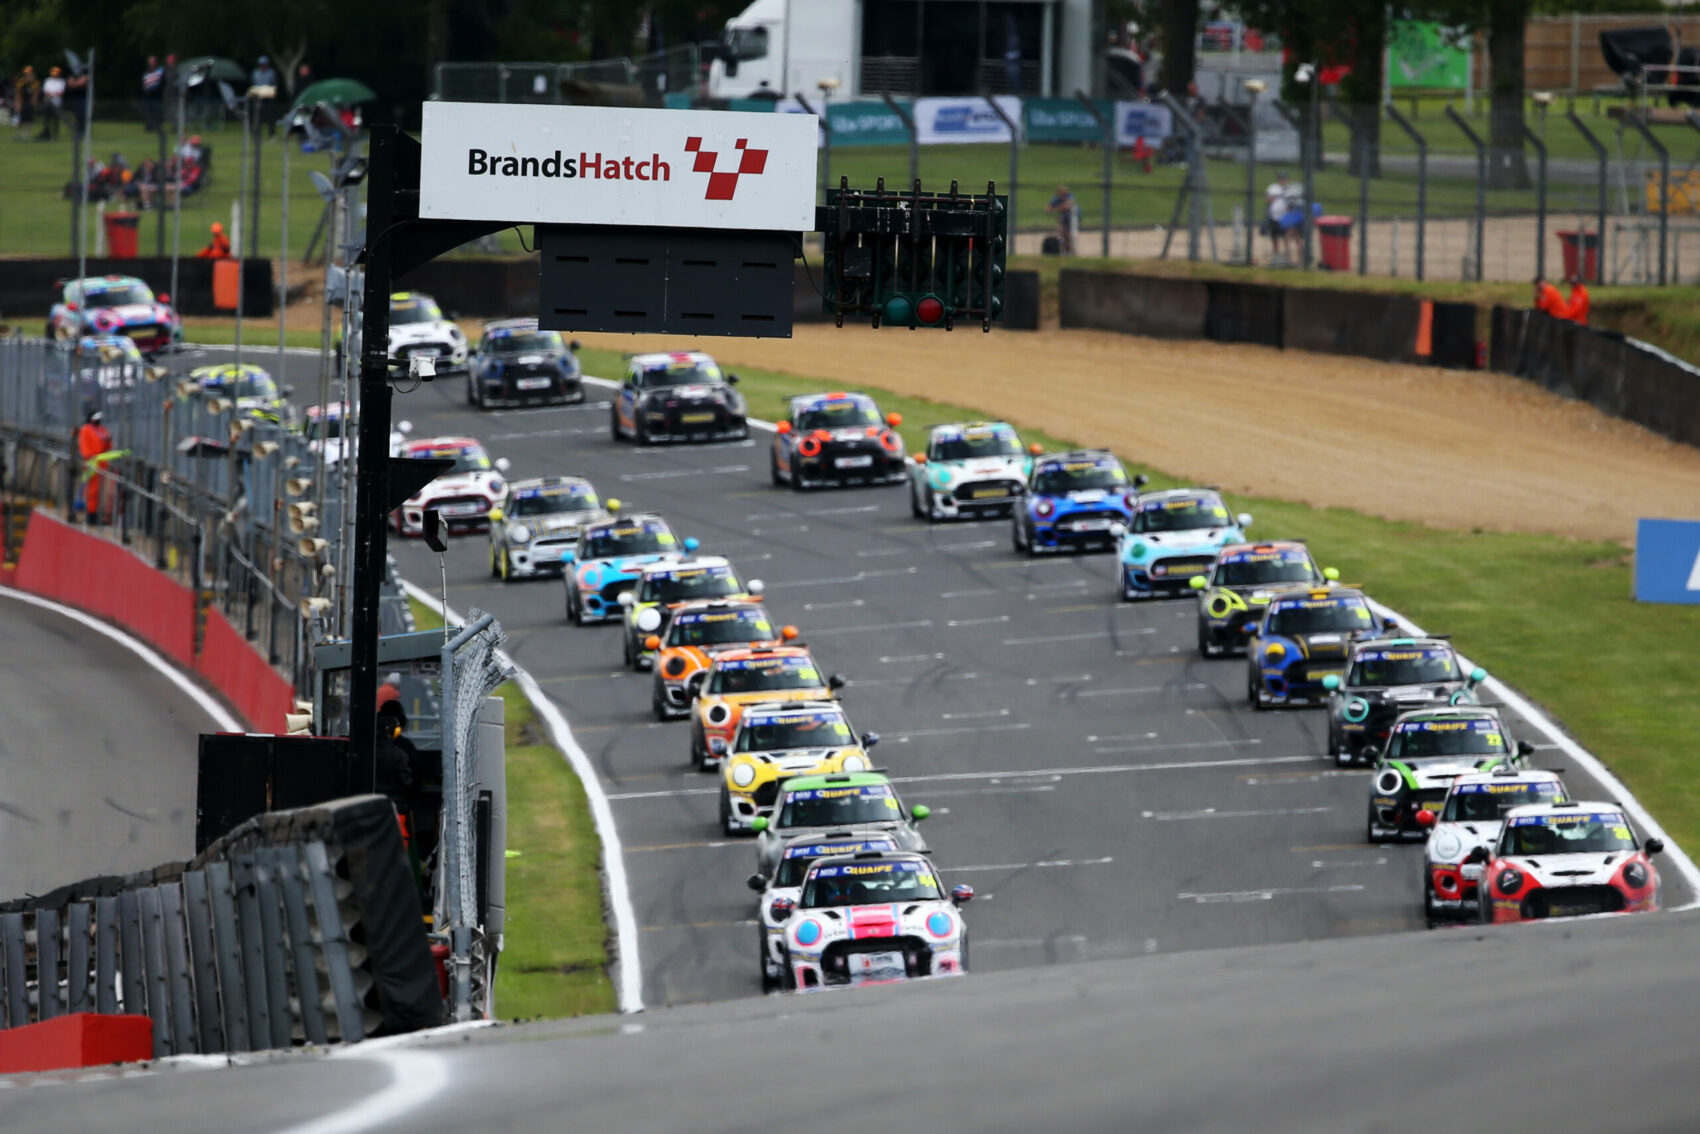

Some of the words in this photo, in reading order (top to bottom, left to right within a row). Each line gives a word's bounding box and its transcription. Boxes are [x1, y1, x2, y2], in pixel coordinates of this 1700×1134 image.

[468, 149, 671, 181] BrandsHatch
[1548, 815, 1591, 824] QUAIFE
[850, 864, 894, 875] QUAIFE
